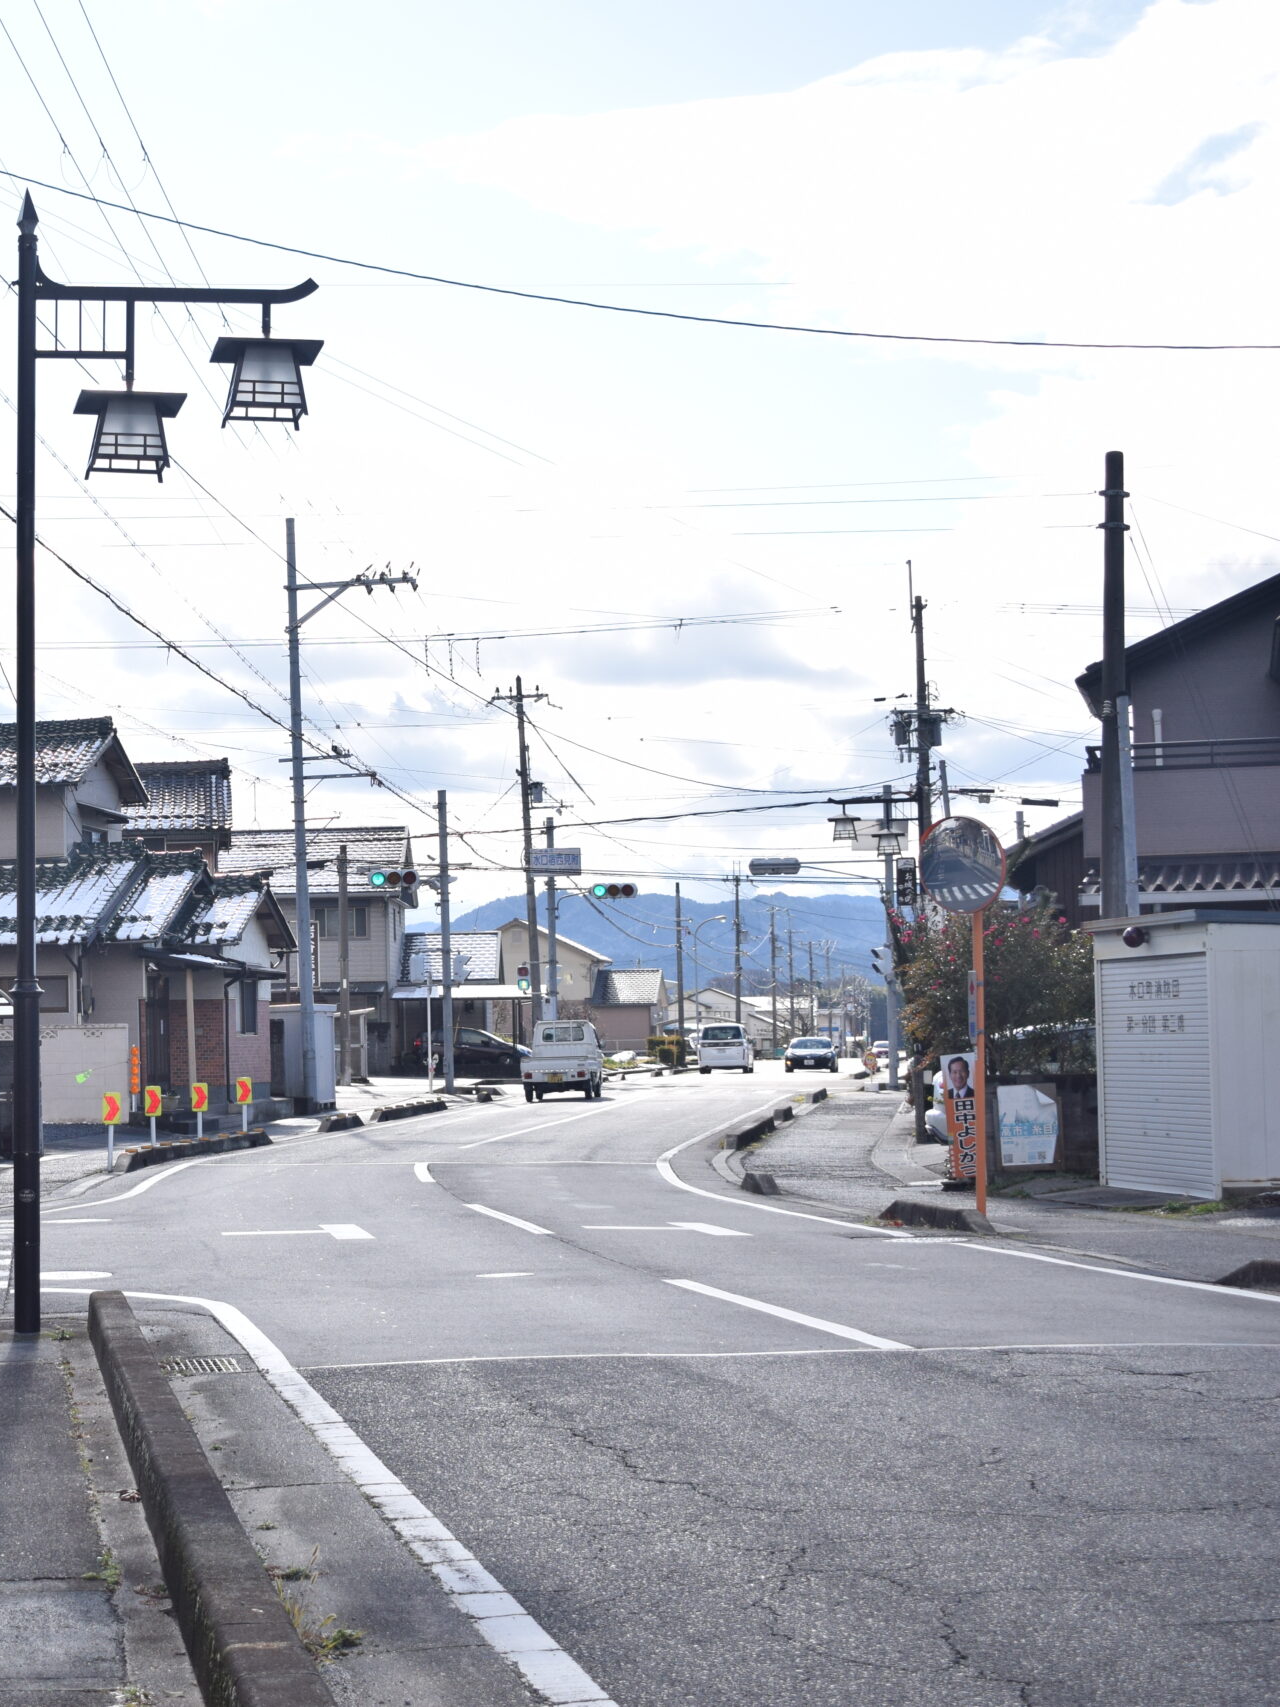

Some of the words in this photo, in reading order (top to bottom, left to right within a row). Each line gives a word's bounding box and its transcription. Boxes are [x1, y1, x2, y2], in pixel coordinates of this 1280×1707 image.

[1128, 979, 1179, 1000] 水口町消防団
